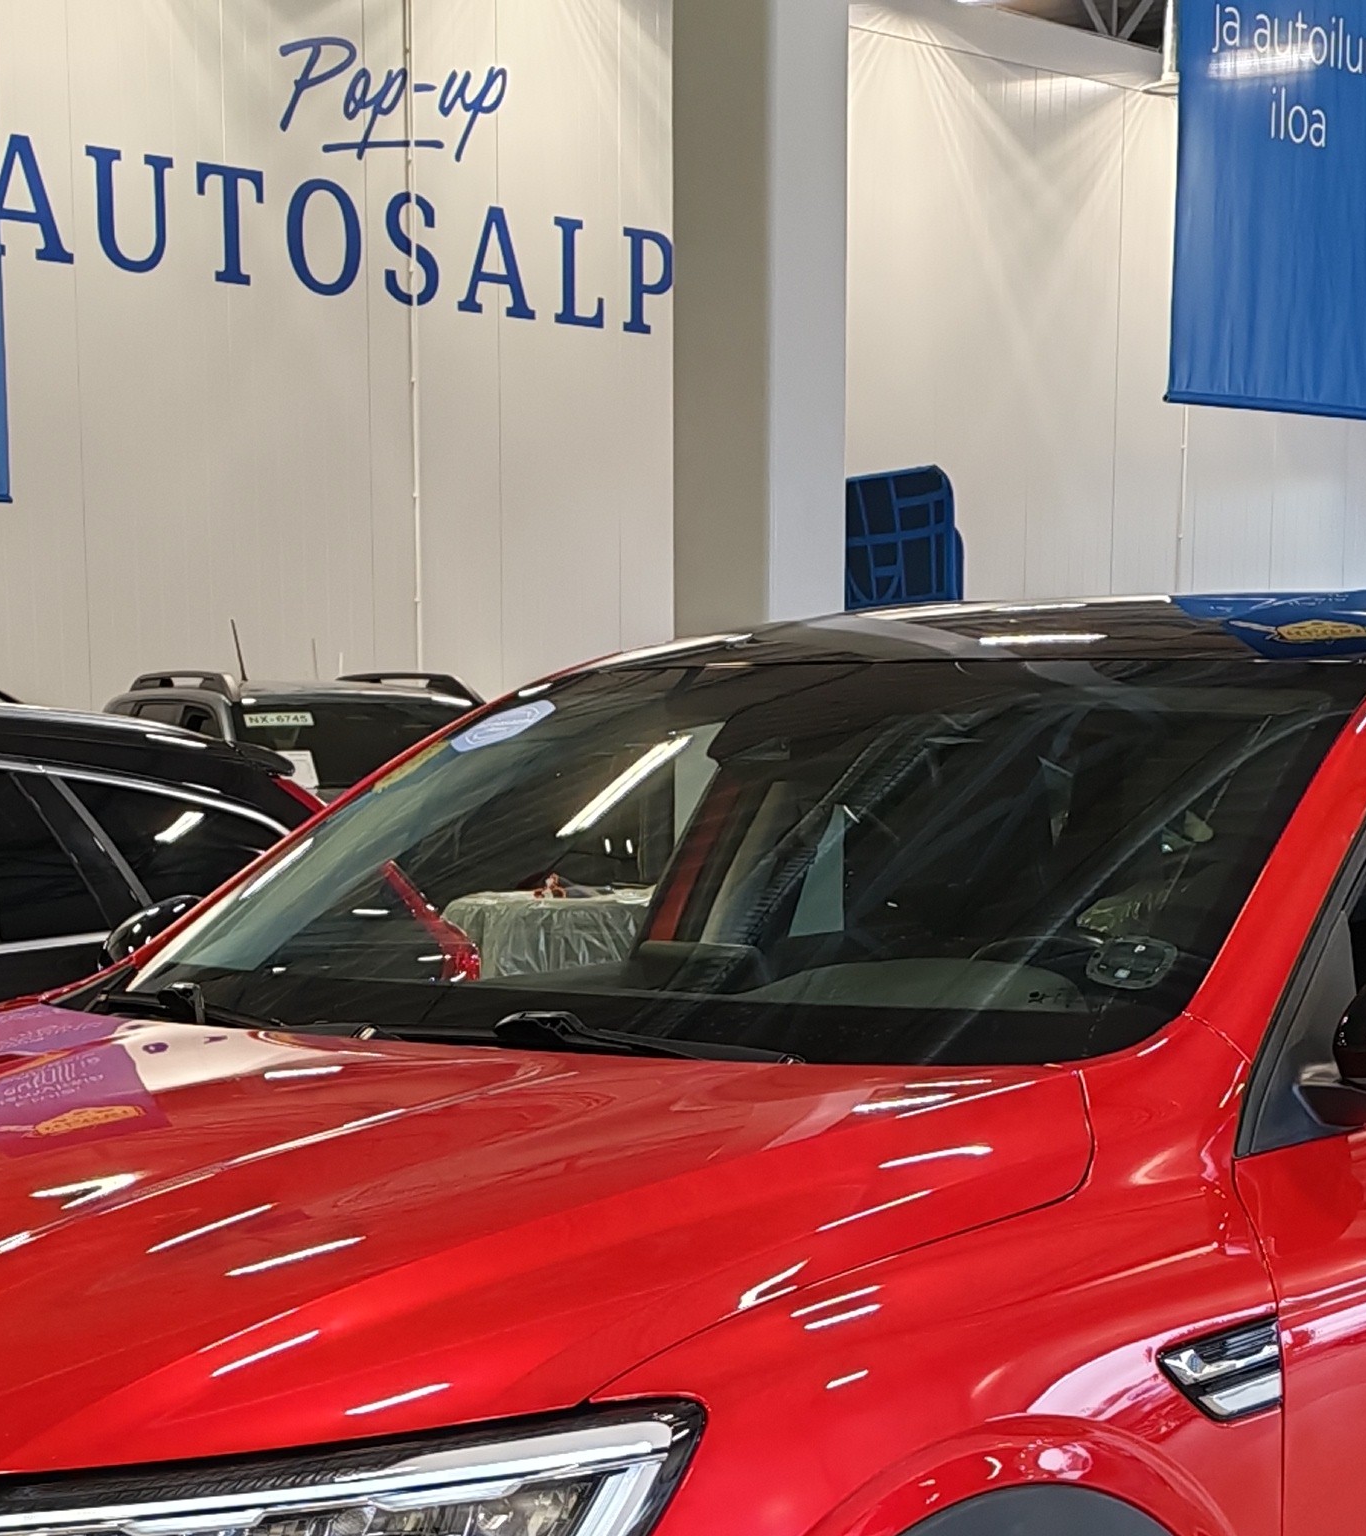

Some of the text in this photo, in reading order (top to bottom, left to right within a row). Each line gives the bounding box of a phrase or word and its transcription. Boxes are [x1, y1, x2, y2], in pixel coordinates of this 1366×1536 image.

[1212, 2, 1240, 53] ja
[279, 36, 508, 162] Pop-up
[1269, 87, 1326, 147] iloa
